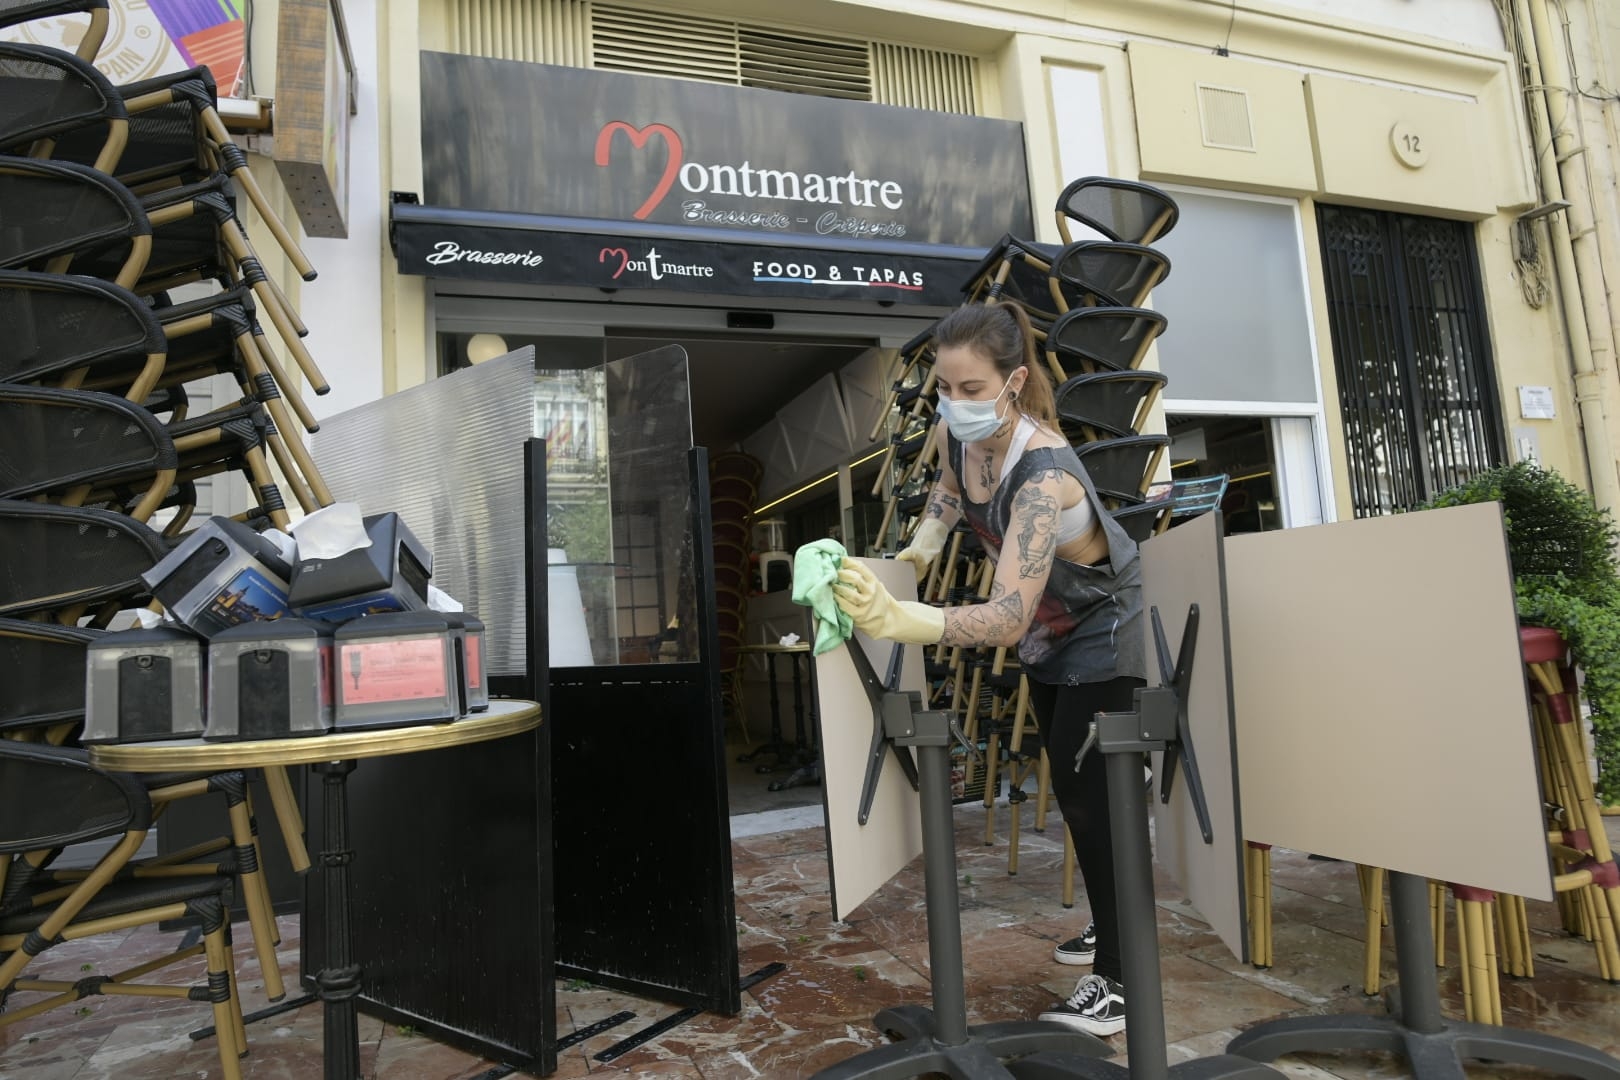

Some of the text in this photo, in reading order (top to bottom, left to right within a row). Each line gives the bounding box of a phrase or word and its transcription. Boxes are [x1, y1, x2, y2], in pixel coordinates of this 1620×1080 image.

[97, 47, 145, 78] PAIN
[1402, 134, 1420, 152] 12
[594, 120, 903, 220] Montmartre
[681, 199, 790, 228] Brasserie
[426, 241, 544, 267] Brasserie
[752, 261, 924, 286] FOOD & TAPAS
